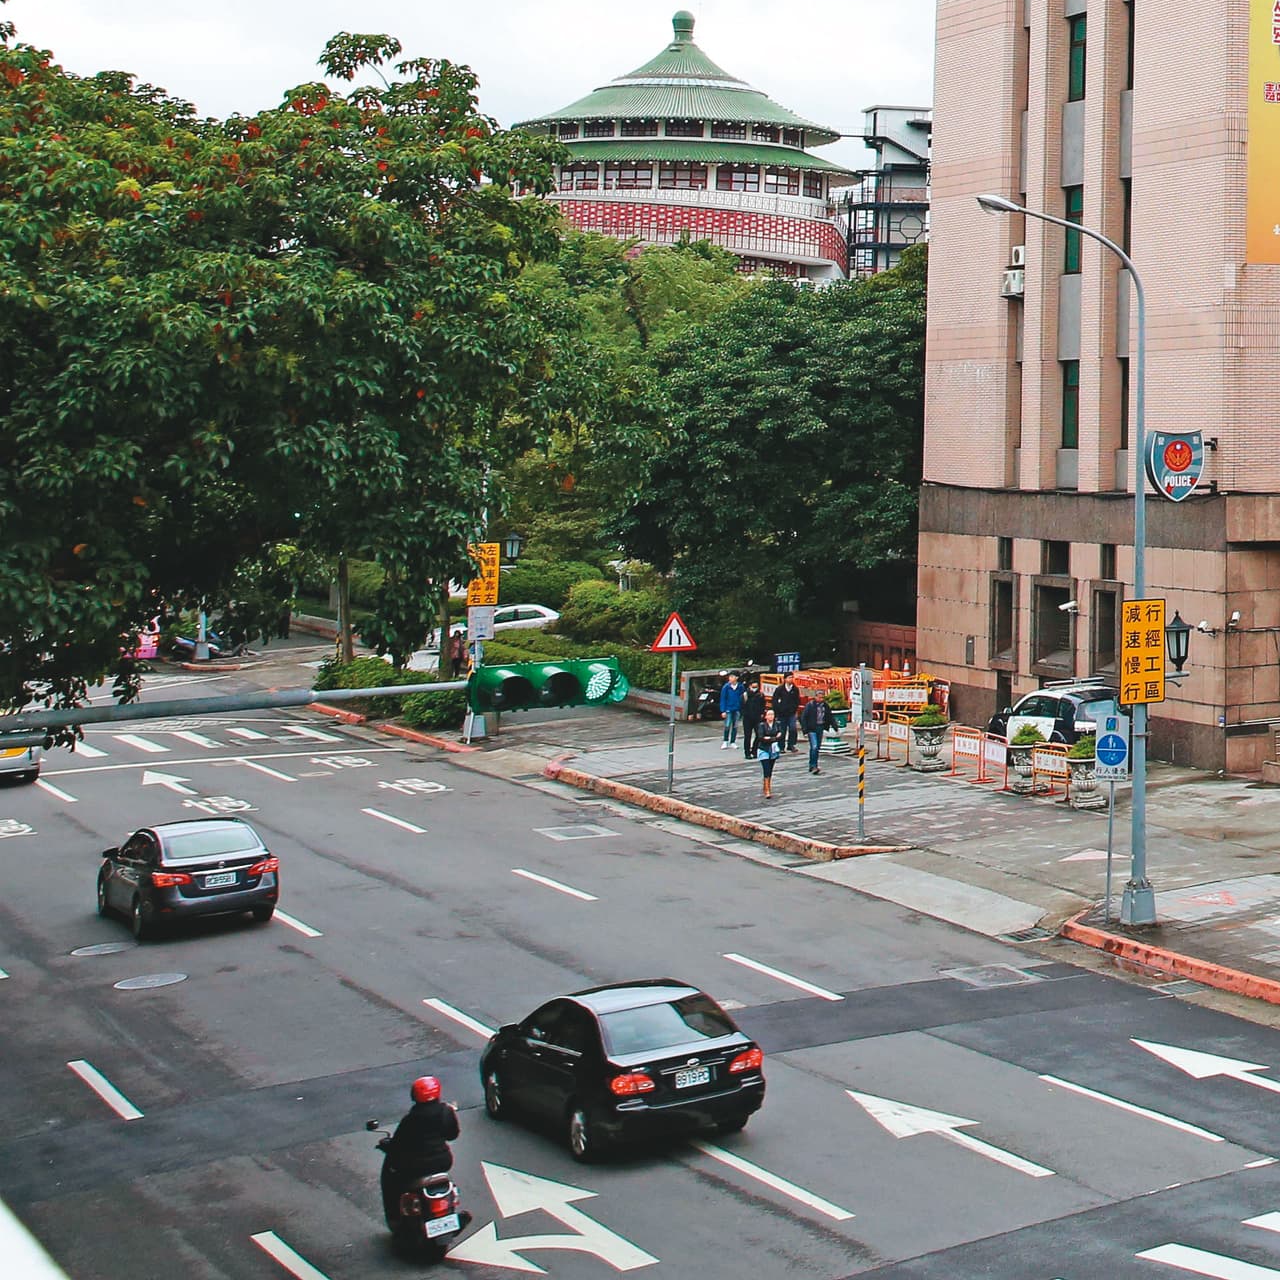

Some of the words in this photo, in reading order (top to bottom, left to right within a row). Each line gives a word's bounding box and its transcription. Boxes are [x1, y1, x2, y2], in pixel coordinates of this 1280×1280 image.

[1164, 475, 1192, 487] POLICE
[1124, 604, 1142, 702] 減速慢行
[1144, 603, 1161, 699] 行經工區
